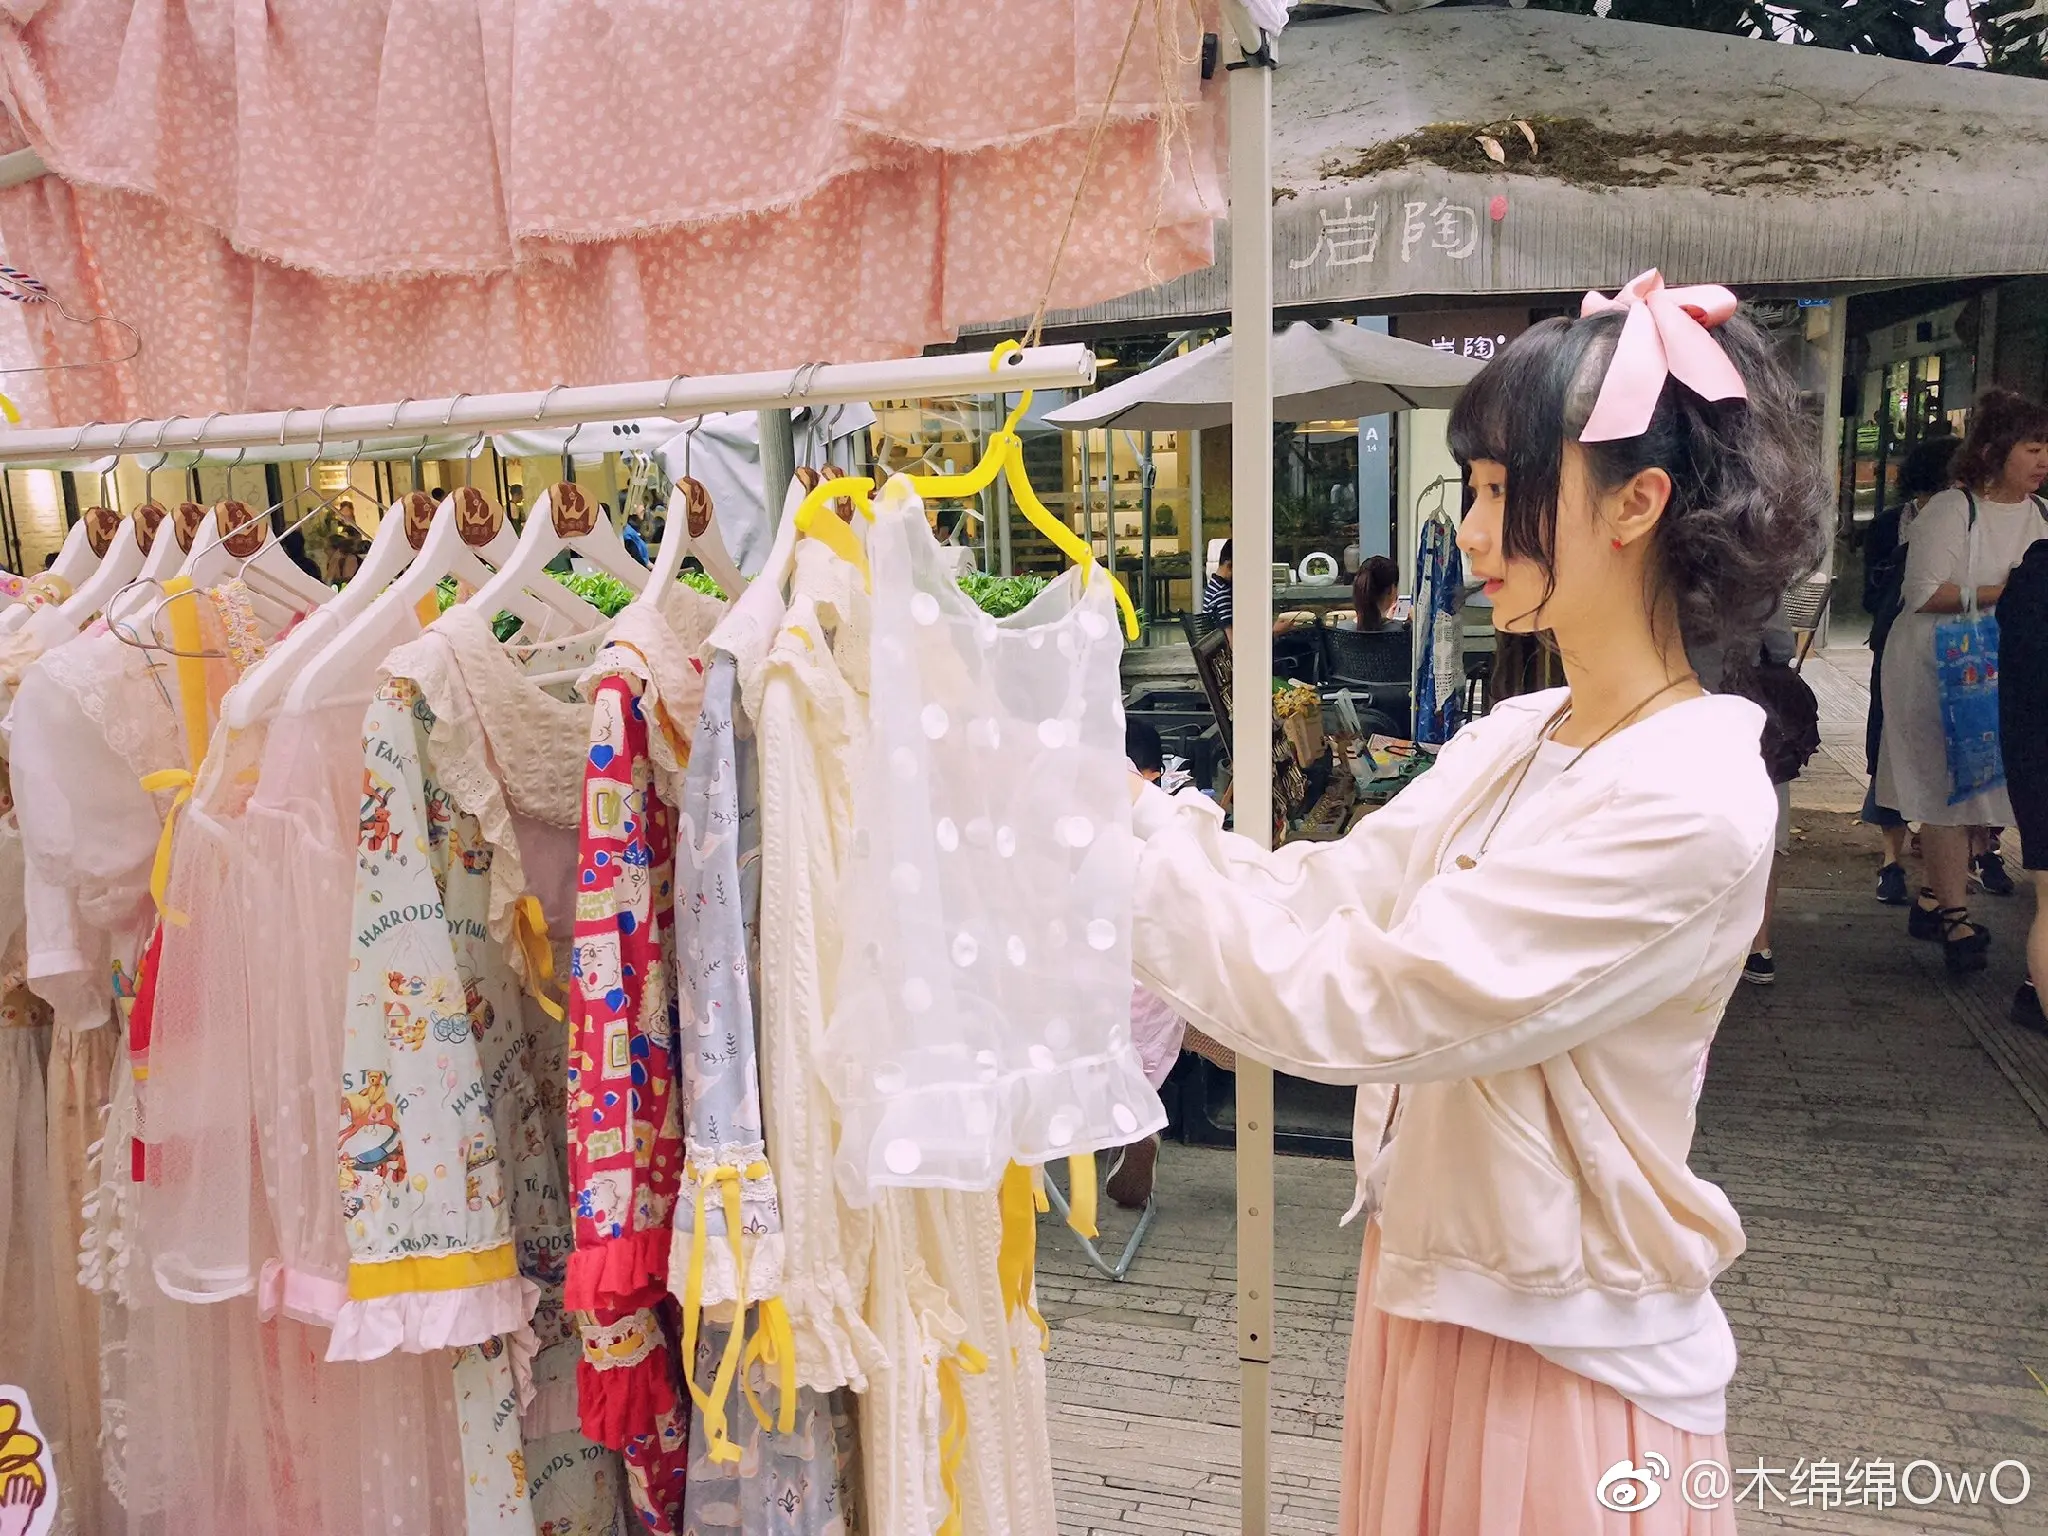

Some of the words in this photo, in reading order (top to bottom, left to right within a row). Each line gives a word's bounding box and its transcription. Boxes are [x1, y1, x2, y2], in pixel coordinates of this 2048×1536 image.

[1289, 197, 1478, 269] 岩陶
[1365, 427, 1379, 441] A
[358, 902, 444, 948] HARRODS
